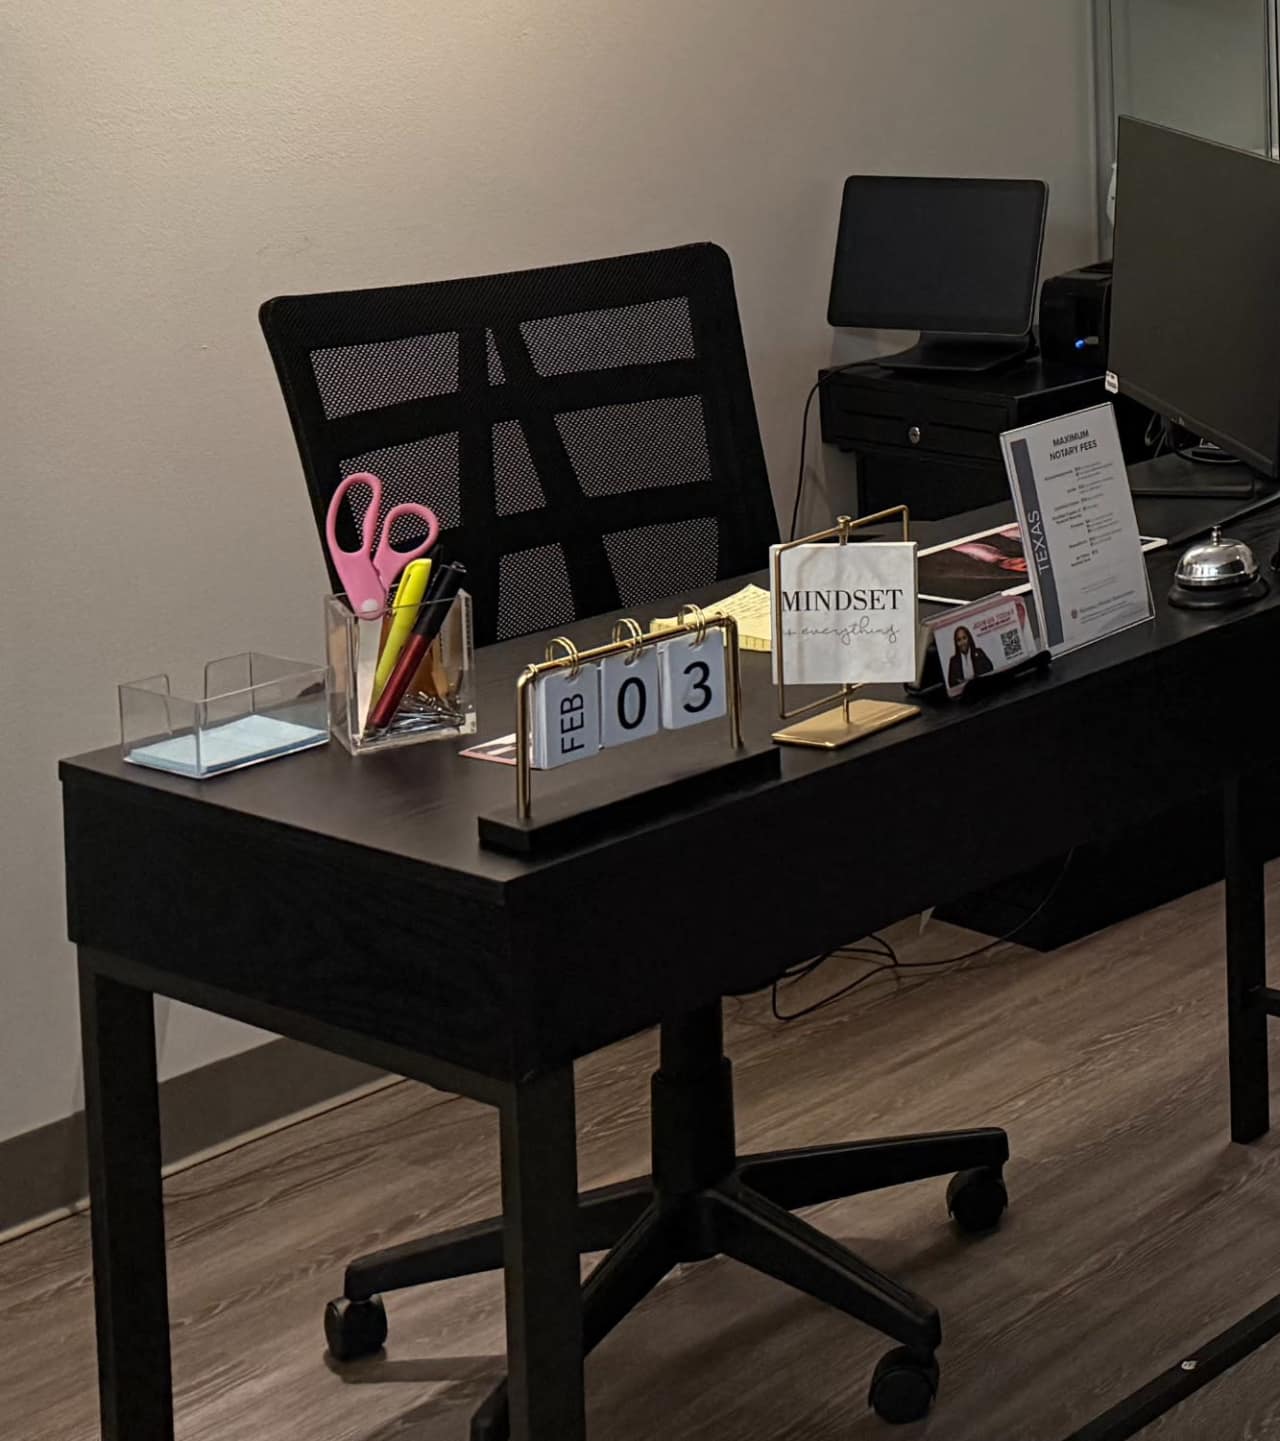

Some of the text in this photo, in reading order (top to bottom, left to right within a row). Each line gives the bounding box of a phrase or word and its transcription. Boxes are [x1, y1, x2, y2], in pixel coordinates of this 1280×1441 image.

[1050, 440, 1097, 461] NOTARY FEES
[1052, 430, 1089, 446] MAXIMUM
[1028, 510, 1049, 574] TEXAS
[782, 589, 903, 611] MINDSET
[801, 616, 899, 645] everything
[561, 693, 584, 754] FEB
